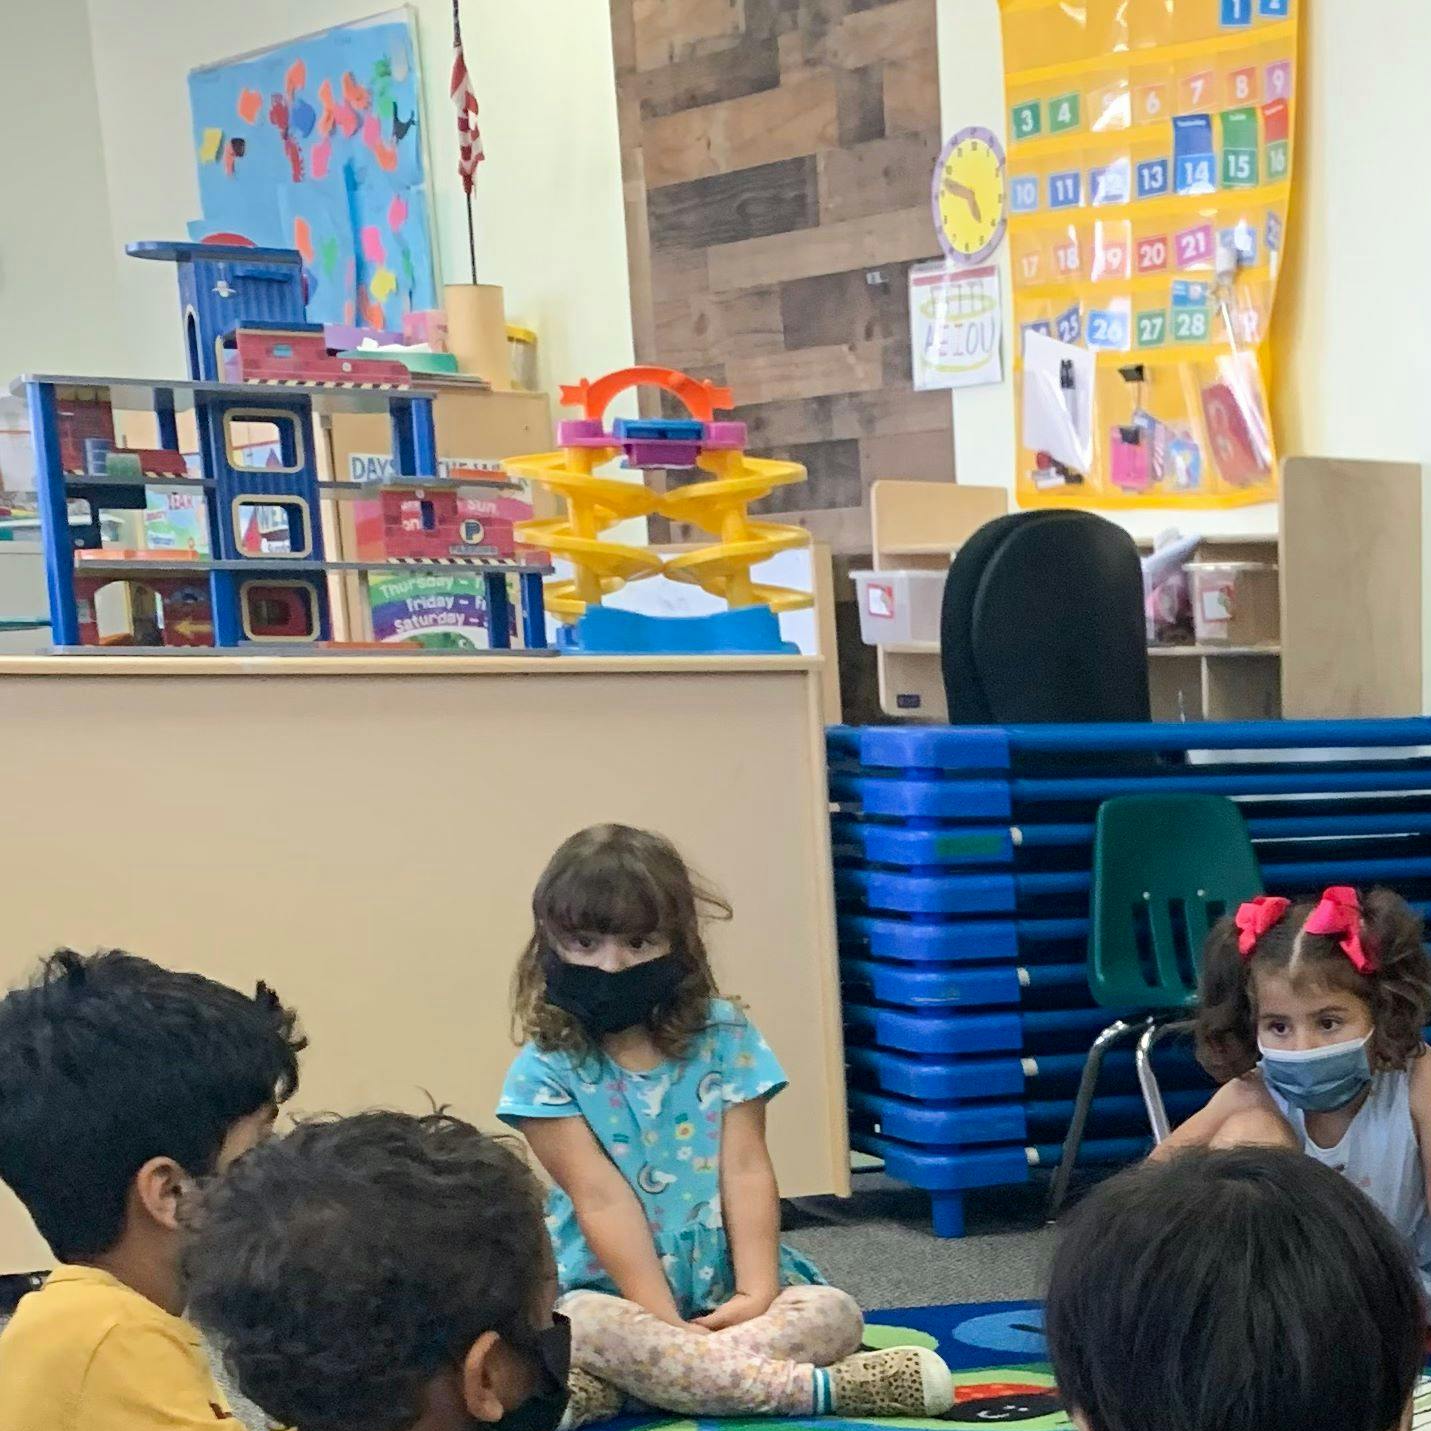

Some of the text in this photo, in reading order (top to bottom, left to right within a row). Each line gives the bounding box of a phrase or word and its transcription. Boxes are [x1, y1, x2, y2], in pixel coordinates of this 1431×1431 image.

[1021, 69, 1286, 132] 3 4 6 7 8 9
[1015, 183, 1035, 204] 10
[1055, 179, 1074, 201] 11
[1141, 166, 1165, 190] 13
[1184, 161, 1210, 184] 14
[1227, 155, 1251, 179] 15
[1268, 149, 1286, 172] 16
[1021, 254, 1040, 277] 17
[1057, 248, 1080, 270] 18
[1140, 245, 1166, 268] 20
[1181, 231, 1206, 259] 21
[1058, 313, 1079, 341] 25
[1093, 320, 1123, 342] 26
[1140, 317, 1163, 341] 27
[1177, 314, 1206, 337] 28
[379, 576, 454, 599] Thursday
[393, 612, 465, 633] Saturday
